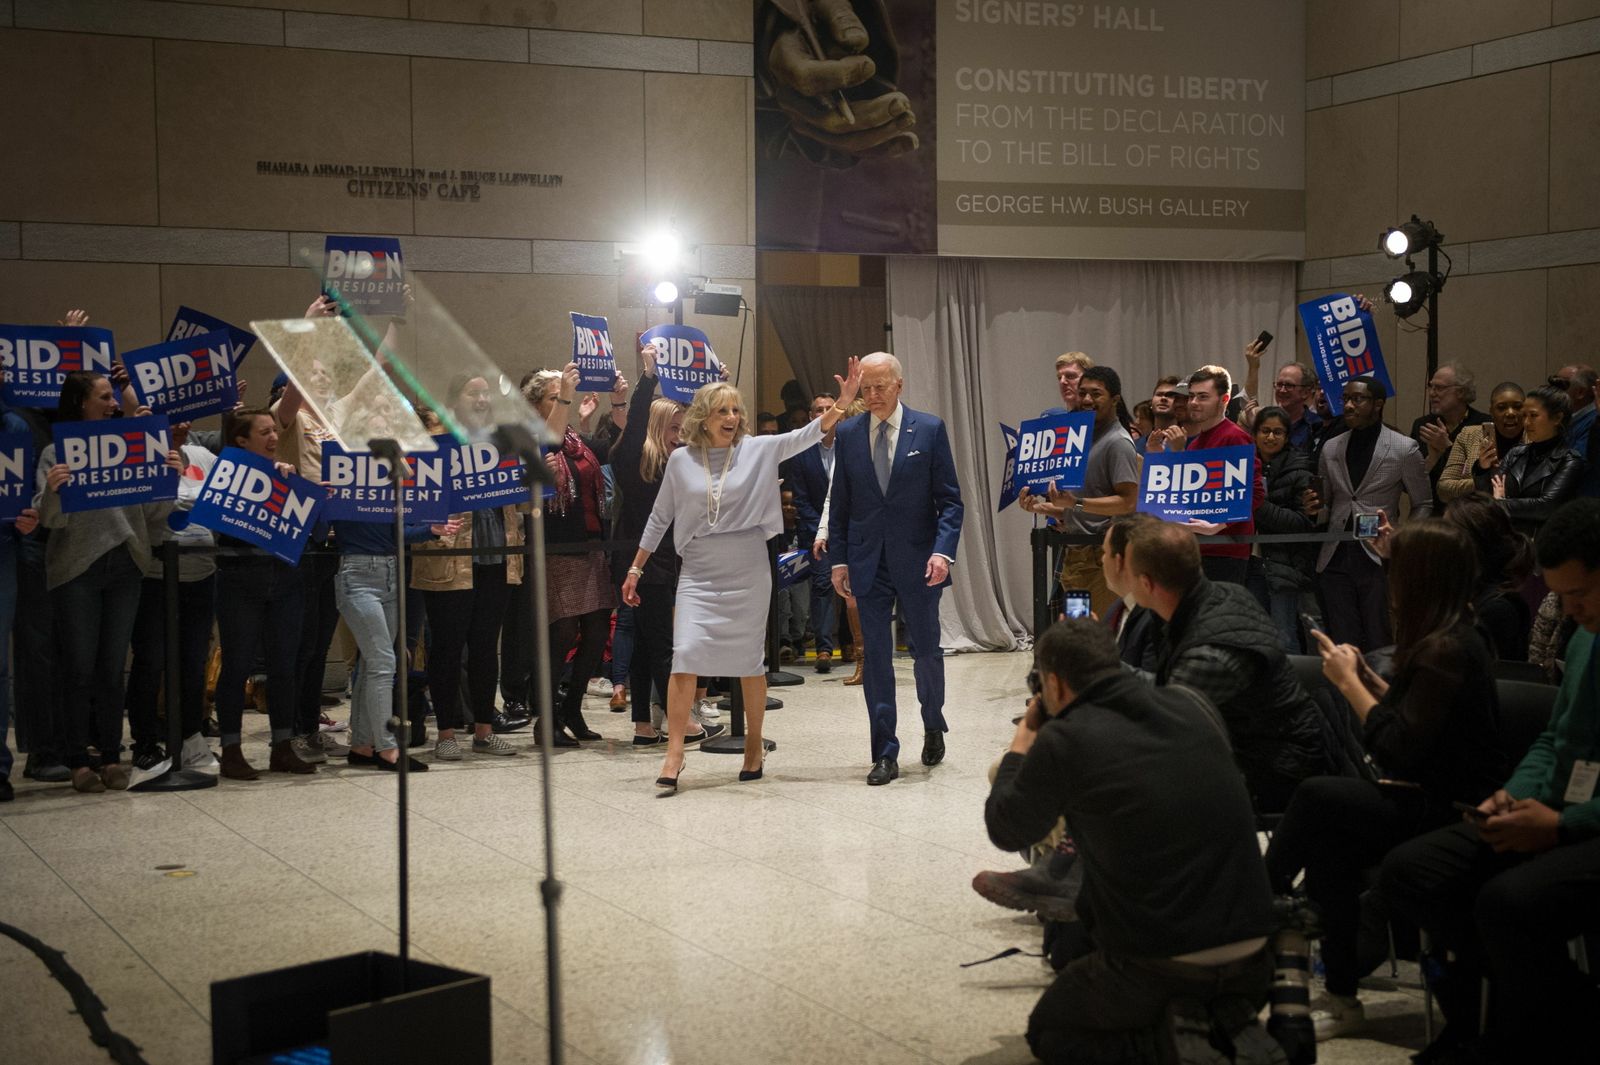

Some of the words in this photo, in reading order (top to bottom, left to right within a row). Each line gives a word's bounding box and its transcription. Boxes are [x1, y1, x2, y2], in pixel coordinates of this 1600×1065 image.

[1093, 6, 1164, 32] HALL
[955, 67, 1154, 98] CONSTITUTING
[1164, 75, 1269, 101] LIBERTY
[956, 103, 1033, 129] FROM
[1043, 106, 1093, 131] THE
[1103, 108, 1285, 137] DECLARATION
[956, 139, 992, 163] TO
[1001, 140, 1052, 165] THE
[1063, 142, 1116, 167] BILL
[1126, 144, 1161, 167] OF
[1171, 146, 1261, 171] RIGHTS
[428, 171, 447, 180] and
[449, 170, 458, 181] J.
[460, 171, 496, 183] BRUCE
[499, 172, 563, 185] LLEWELLYN
[437, 182, 480, 199] CAFÉ
[956, 194, 1044, 213] GEORGE
[1051, 196, 1093, 214] H.W.
[1100, 197, 1152, 216] BUSH
[1159, 199, 1250, 217] GALLERY
[327, 250, 402, 280] BIDEN
[576, 326, 613, 357] BIDEN
[1318, 303, 1349, 387] PRESIDE
[1329, 296, 1375, 378] BIDE
[0, 338, 111, 371] BIDEN
[134, 343, 231, 394] BIDEN
[577, 357, 615, 370] PRESIDENT
[650, 336, 720, 370] BIDEN
[657, 366, 720, 383] PRESIDENT
[145, 375, 233, 408] PRESIDENT
[63, 430, 170, 471] BIDEN
[1019, 425, 1088, 461] BIDEN
[67, 464, 169, 487] PRESIDENT
[1017, 455, 1083, 475] PRESIDENT
[1147, 458, 1248, 491] BIDEN
[86, 485, 153, 498] WWW.JOEBIDEN.COM
[208, 459, 316, 527] BIDEN
[1145, 488, 1246, 504] PRESIDENT
[202, 489, 302, 539] PRESIDENT
[221, 514, 235, 524] Text
[235, 519, 248, 529] JOE
[1163, 507, 1228, 516] WWW.JOEBIDEN.COM
